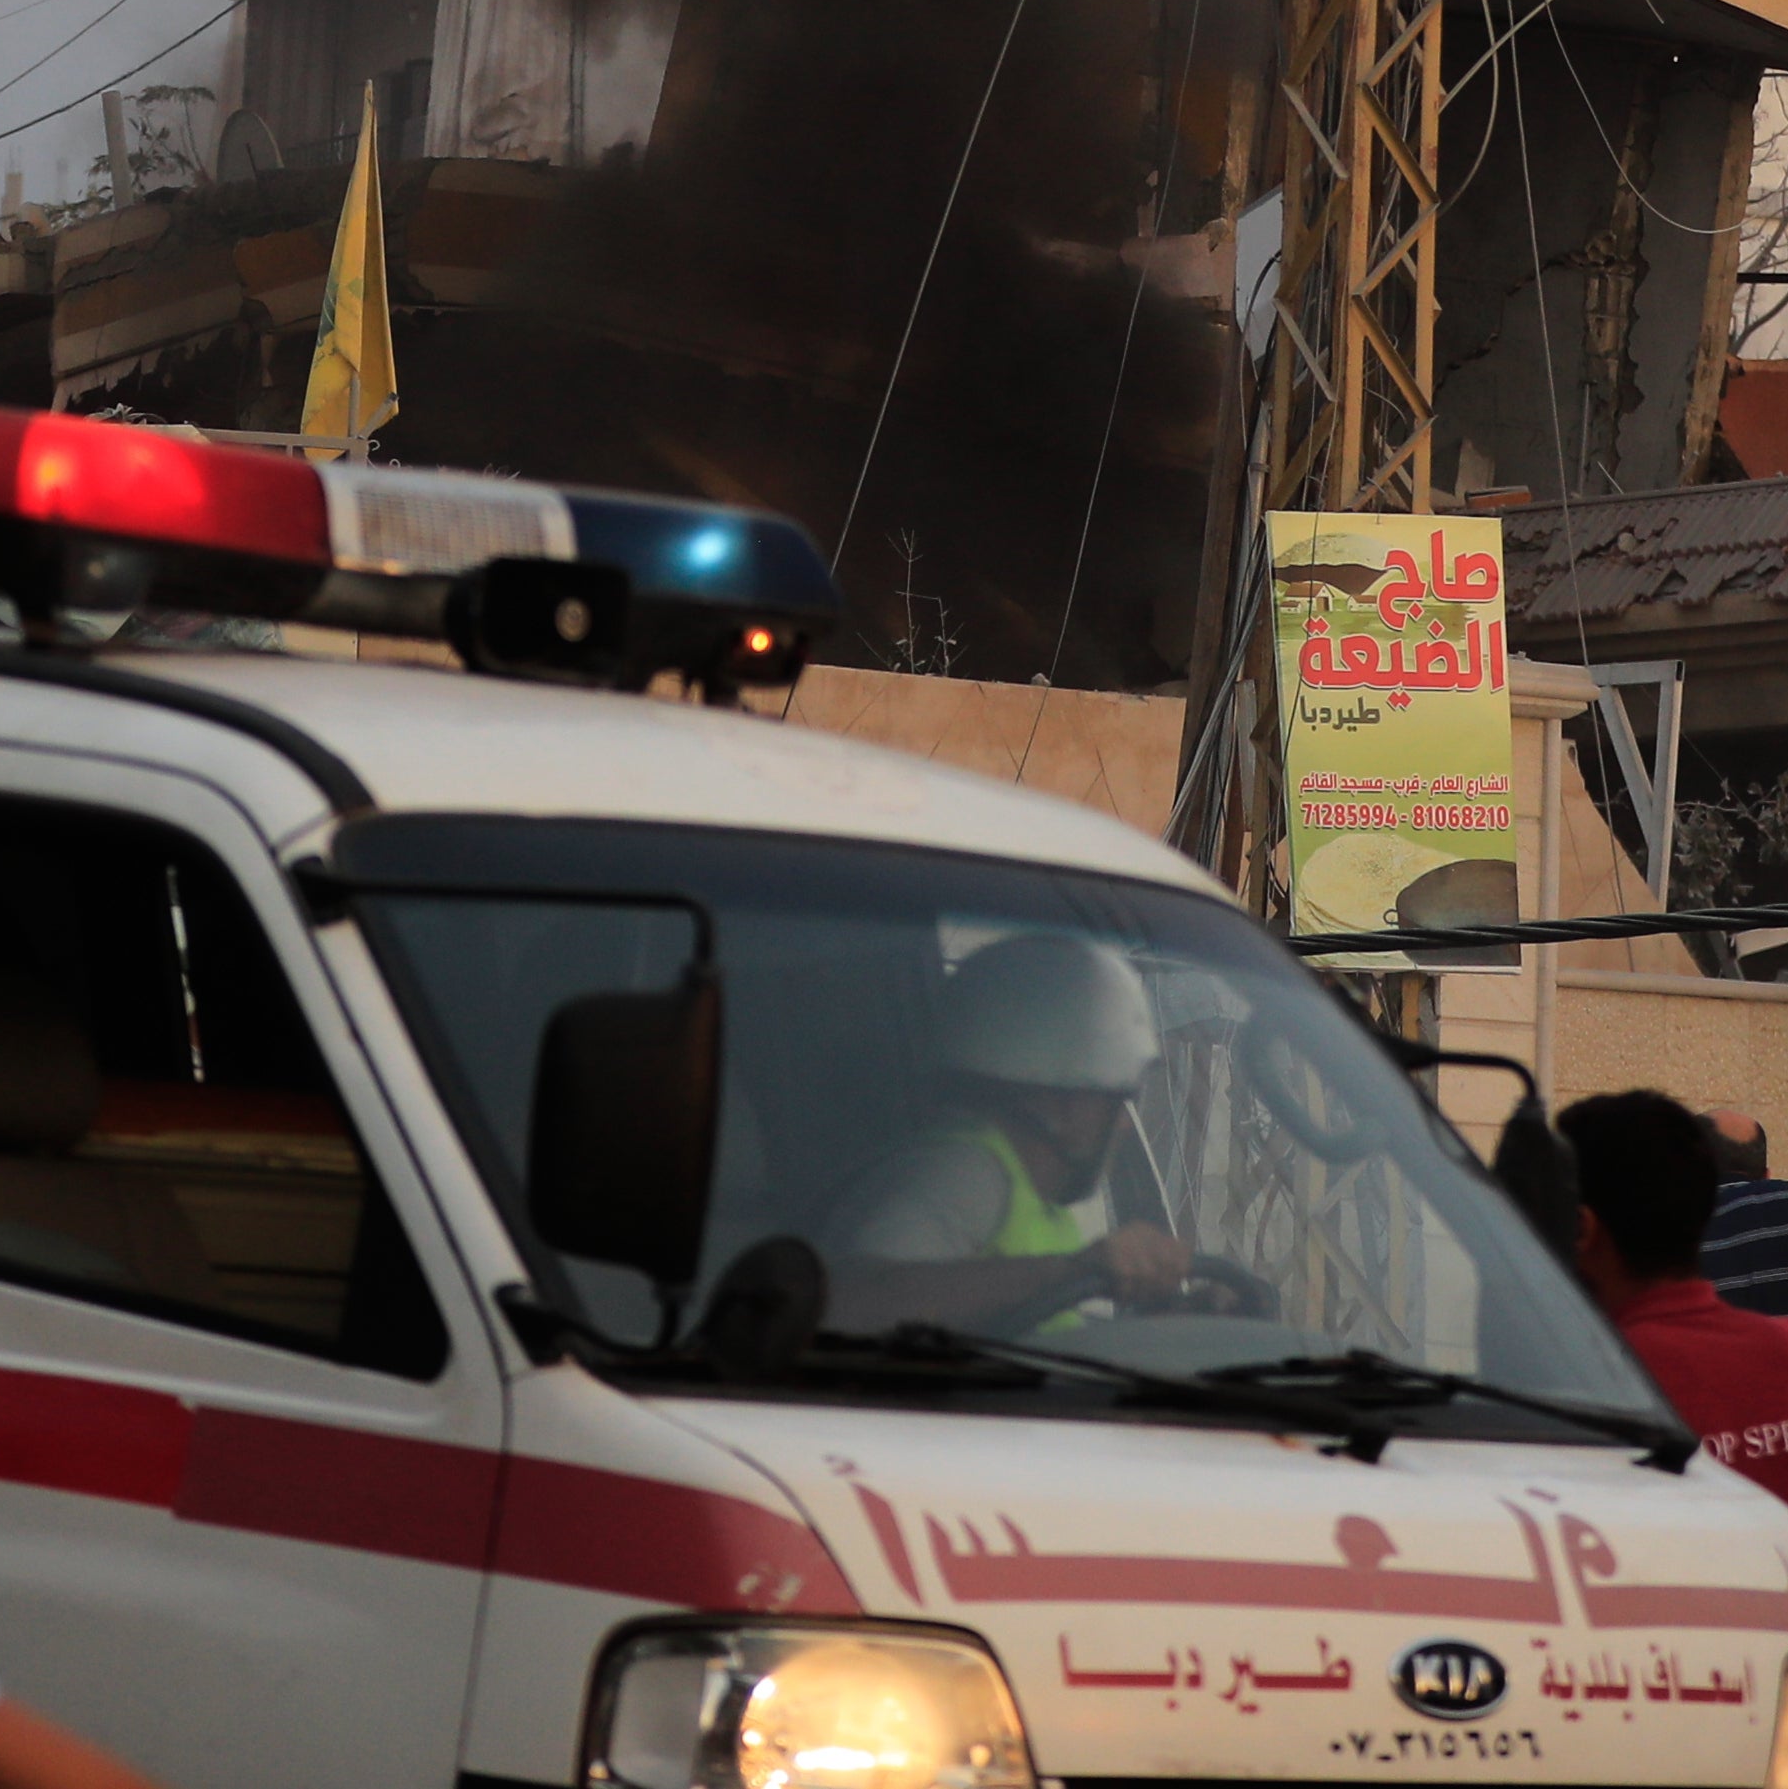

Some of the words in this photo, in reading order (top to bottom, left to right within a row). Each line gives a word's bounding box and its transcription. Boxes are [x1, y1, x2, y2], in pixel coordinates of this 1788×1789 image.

[1376, 528, 1501, 631] صاج
[1298, 615, 1505, 710] الضيعة
[1299, 772, 1338, 796] القائم
[1341, 776, 1383, 796] مسجد
[1430, 774, 1463, 797] العام
[1466, 773, 1509, 798] الشارع
[1301, 803, 1398, 828] 71285994
[1411, 804, 1510, 830] 81068210
[1701, 1430, 1739, 1464] OP
[1411, 1653, 1493, 1702] KIA
[1530, 1638, 1632, 1721] بلدية
